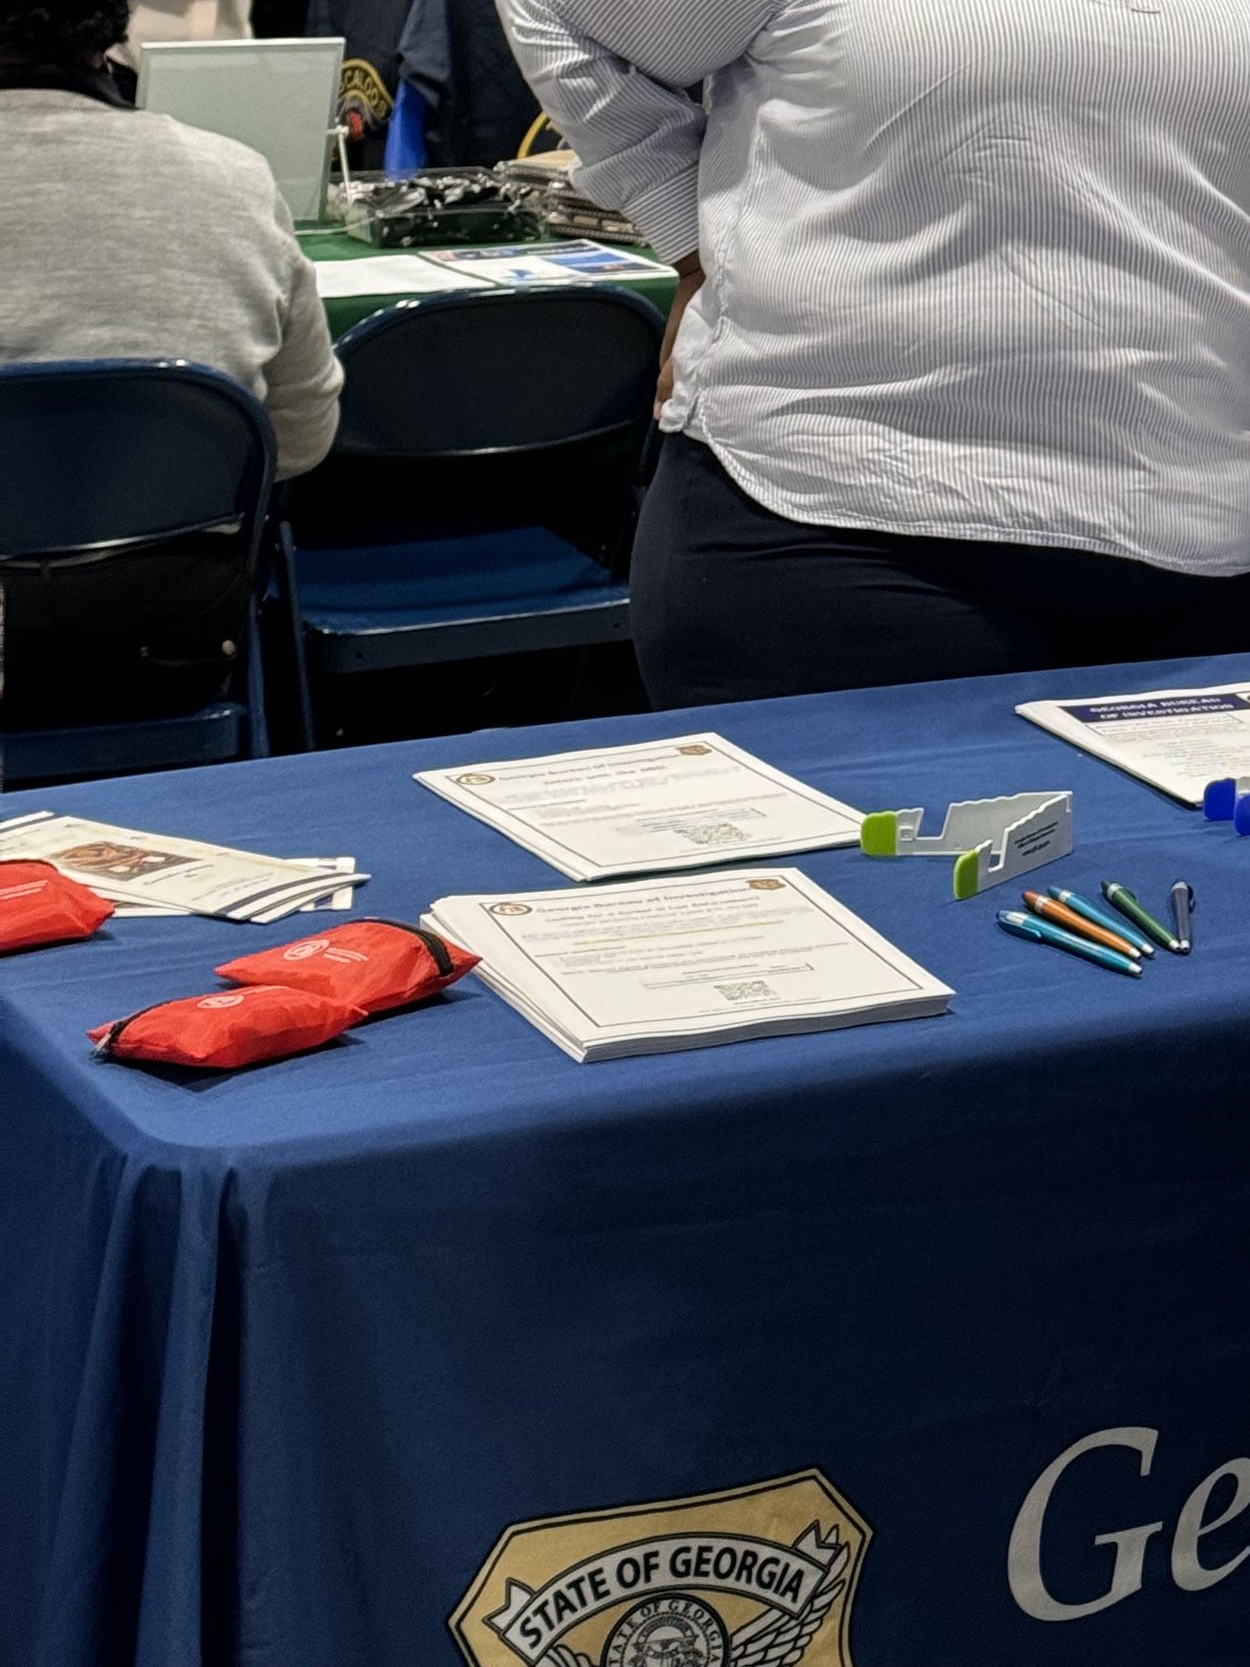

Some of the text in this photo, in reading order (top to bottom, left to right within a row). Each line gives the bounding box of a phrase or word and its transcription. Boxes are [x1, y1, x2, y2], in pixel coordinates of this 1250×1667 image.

[519, 1546, 805, 1650] STATE OF GEORGIA
[606, 1617, 640, 1667] TATE
